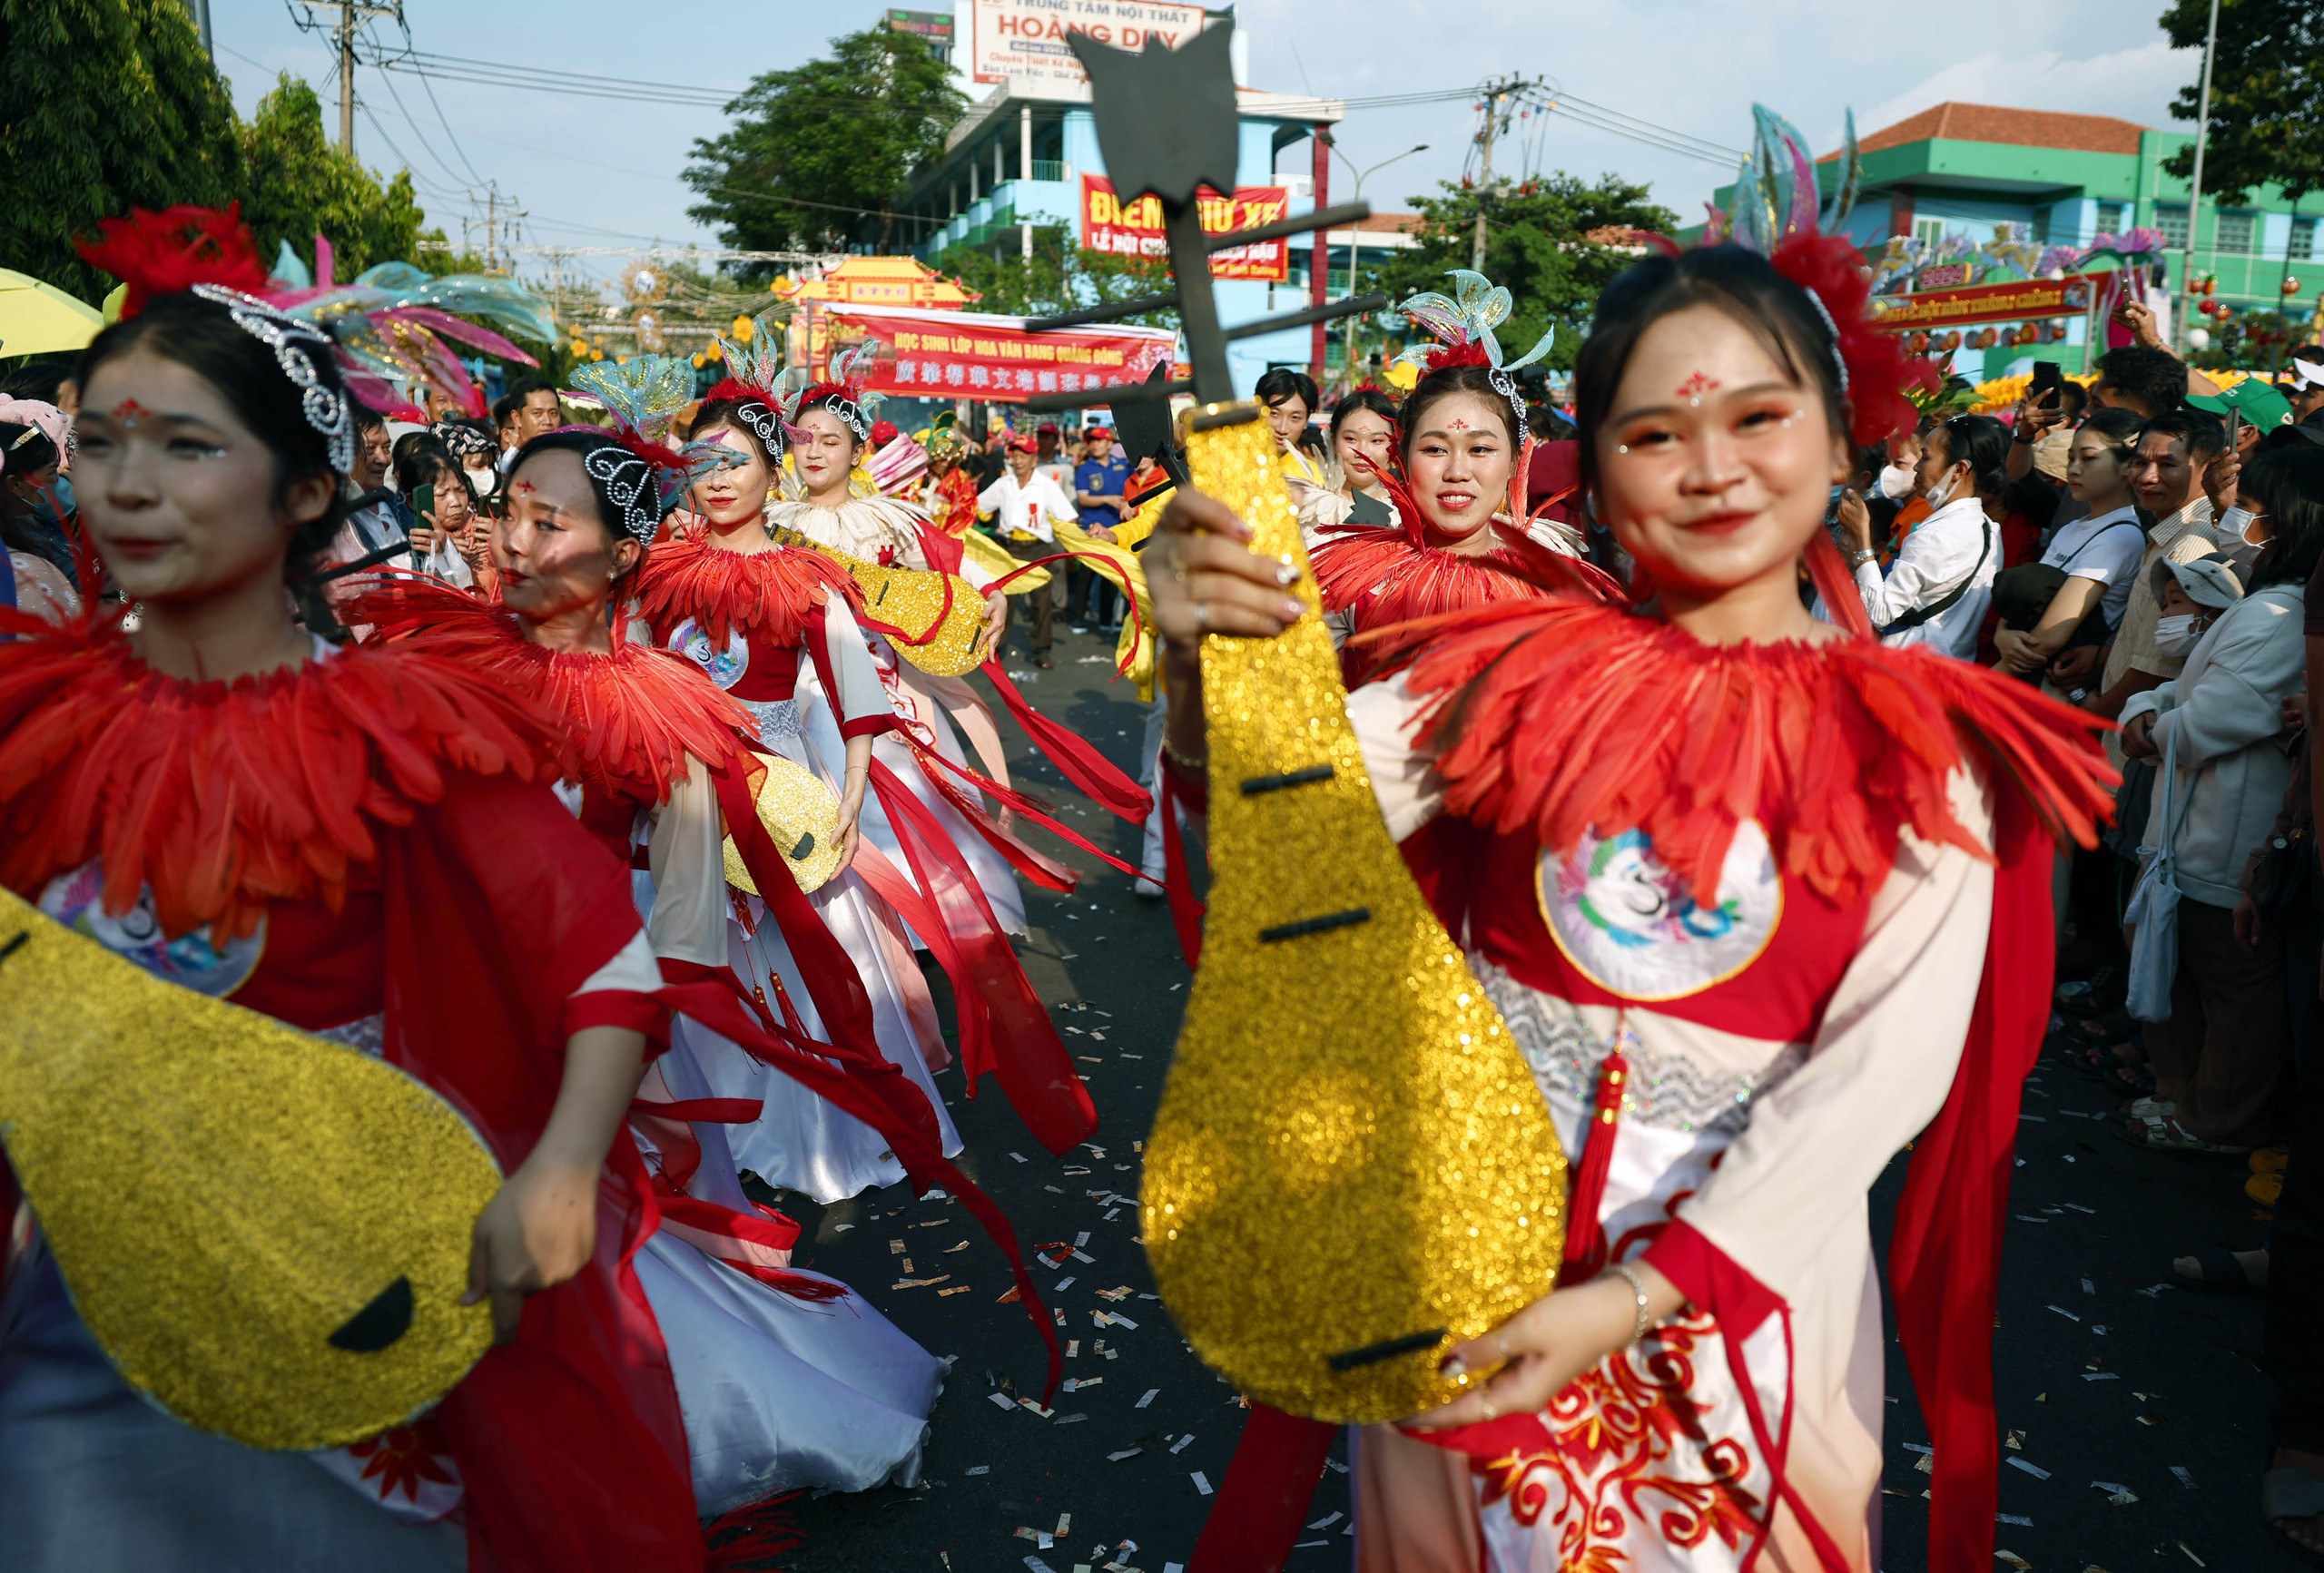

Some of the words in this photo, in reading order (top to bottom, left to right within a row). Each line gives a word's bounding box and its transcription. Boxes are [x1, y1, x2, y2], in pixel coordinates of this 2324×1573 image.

[1116, 6, 1144, 19] NỘI
[1091, 226, 1111, 251] LỄ
[1920, 263, 1965, 289] 2024
[894, 332, 919, 352] HỌC
[921, 334, 950, 352] SINH
[950, 335, 972, 354] LỚP
[974, 339, 998, 357] HOA
[998, 339, 1023, 358] VĂN
[1024, 343, 1055, 361] BANG
[1056, 342, 1092, 364] QUẢNG
[1093, 347, 1124, 366] ĐÔNG
